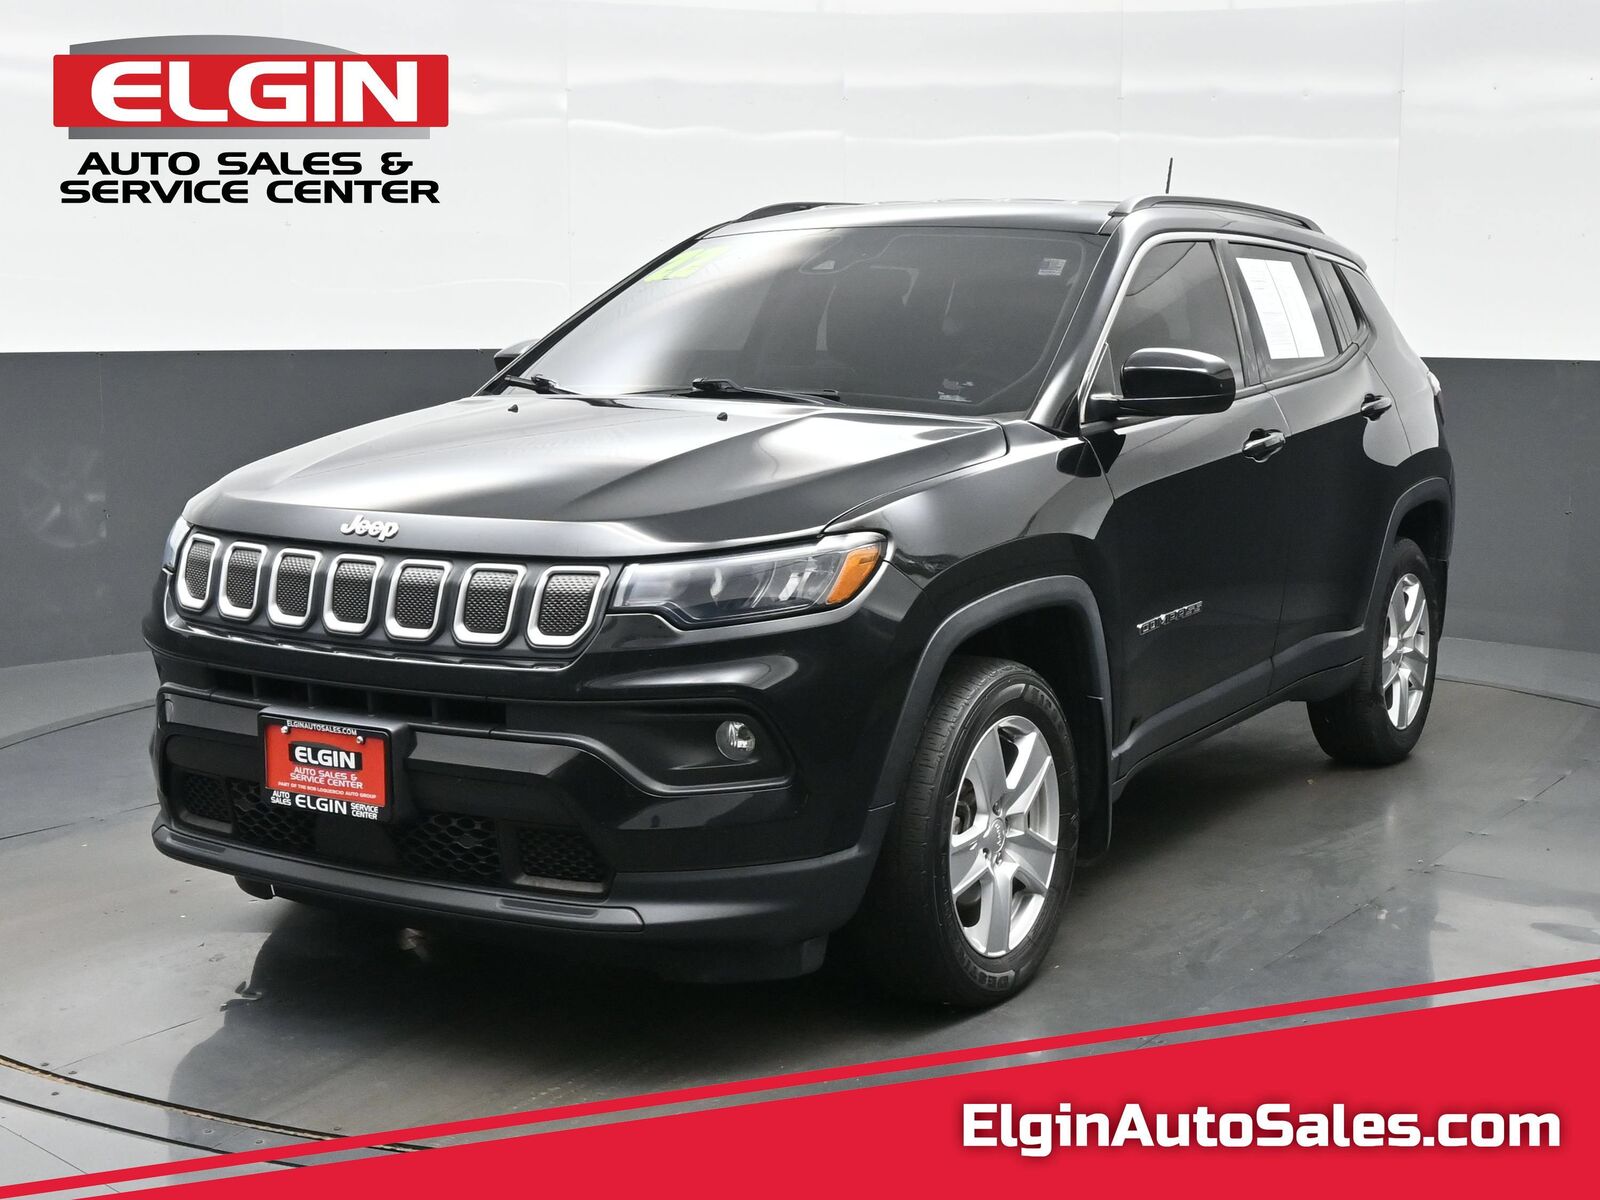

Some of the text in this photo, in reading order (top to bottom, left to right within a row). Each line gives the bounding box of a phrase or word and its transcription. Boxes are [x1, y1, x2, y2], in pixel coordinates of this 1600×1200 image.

[340, 514, 399, 542] Jeep
[286, 720, 357, 736] ELGINAUTOSALES.COM
[294, 746, 356, 769] ELGIN
[290, 772, 363, 789] SERVICE CENTER
[293, 766, 358, 781] AUTO SALES &
[271, 796, 292, 806] SALES
[272, 790, 290, 799] AUTO
[295, 794, 347, 815] ELGIN
[350, 802, 379, 813] SERVICE
[351, 810, 378, 820] CENTER
